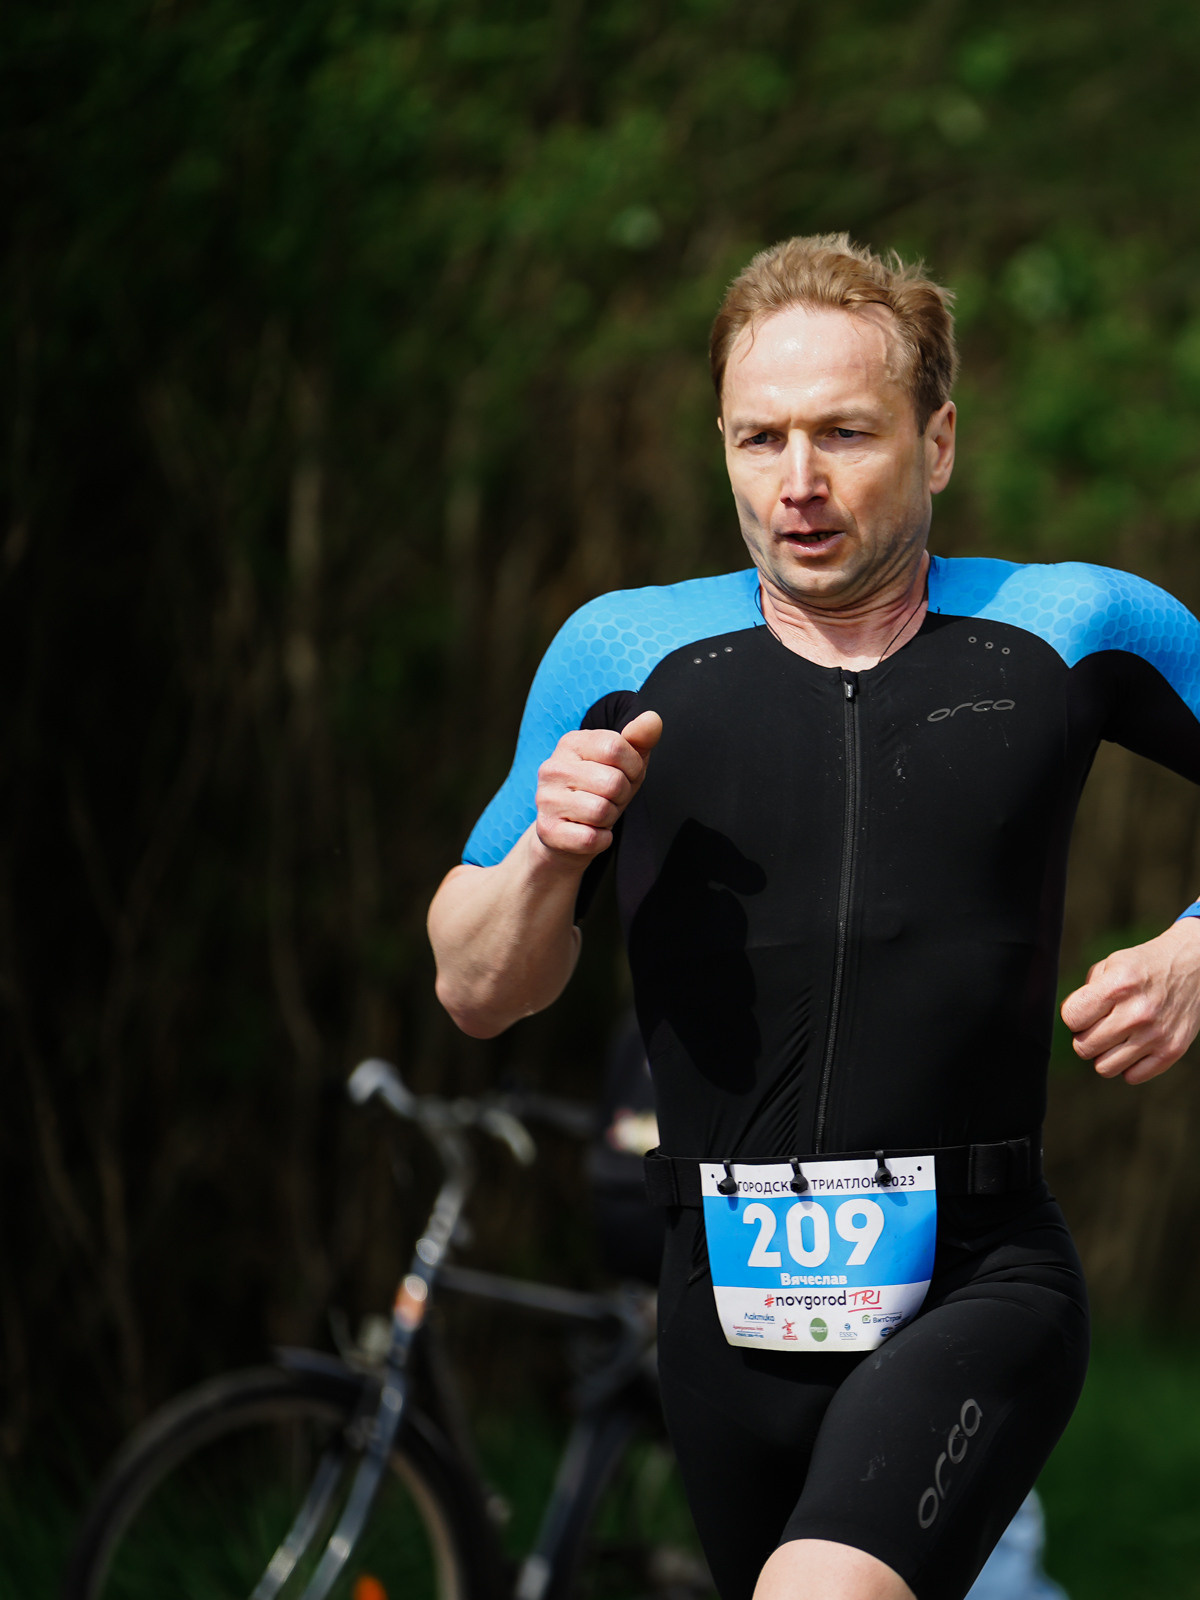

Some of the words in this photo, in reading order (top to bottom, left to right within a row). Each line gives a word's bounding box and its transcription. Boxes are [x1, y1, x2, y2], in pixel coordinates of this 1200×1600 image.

[927, 699, 1016, 722] orca
[716, 1180, 792, 1195] ГОРОДСК
[742, 1198, 885, 1268] 209
[780, 1273, 848, 1286] Вячеслав
[918, 1399, 983, 1529] orca
